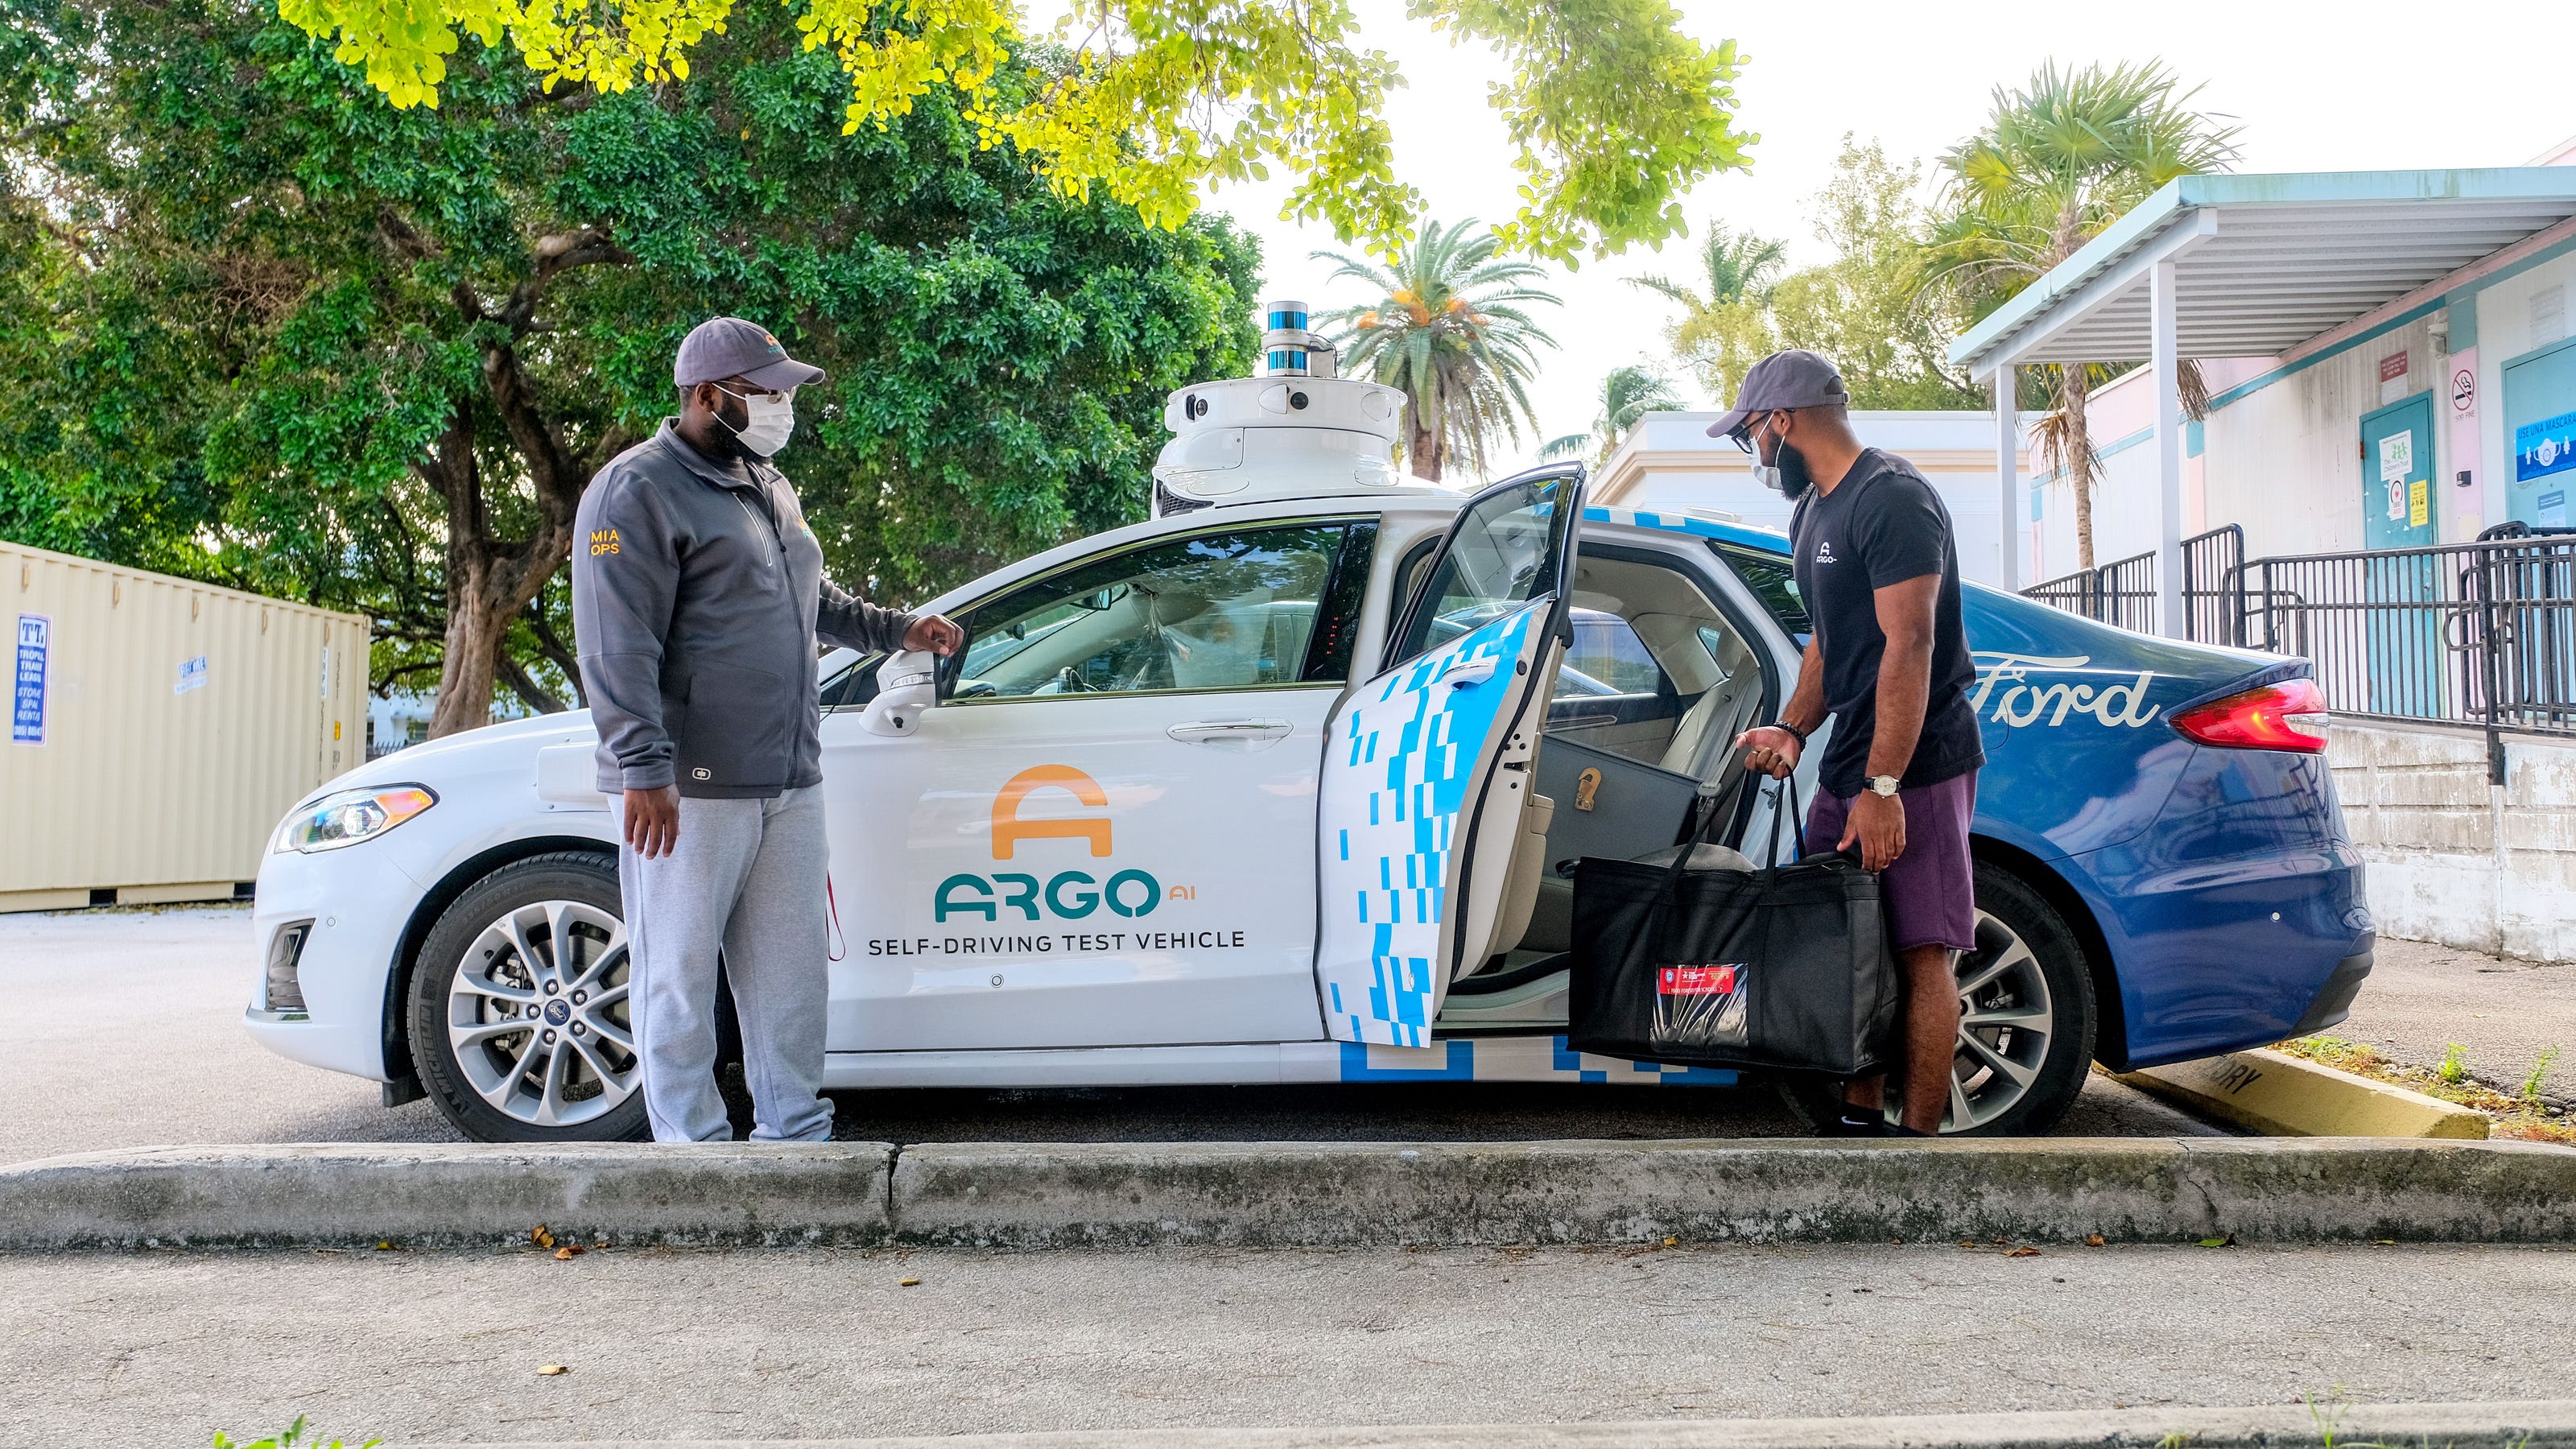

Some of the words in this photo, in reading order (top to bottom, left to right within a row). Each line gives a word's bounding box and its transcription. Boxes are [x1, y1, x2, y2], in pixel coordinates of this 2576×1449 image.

[2518, 427, 2529, 440] USE
[2530, 423, 2544, 436] UNA
[590, 528, 620, 543] MIA
[590, 543, 620, 556] OPS
[1815, 555, 1834, 564] ARGO
[1971, 650, 2161, 728] Ford
[934, 869, 1161, 923] ARGO
[1168, 885, 1196, 901] AI
[868, 935, 1052, 956] SELF-DRIVING
[1061, 933, 1126, 952] TEST
[1134, 930, 1246, 951] VEHICLE
